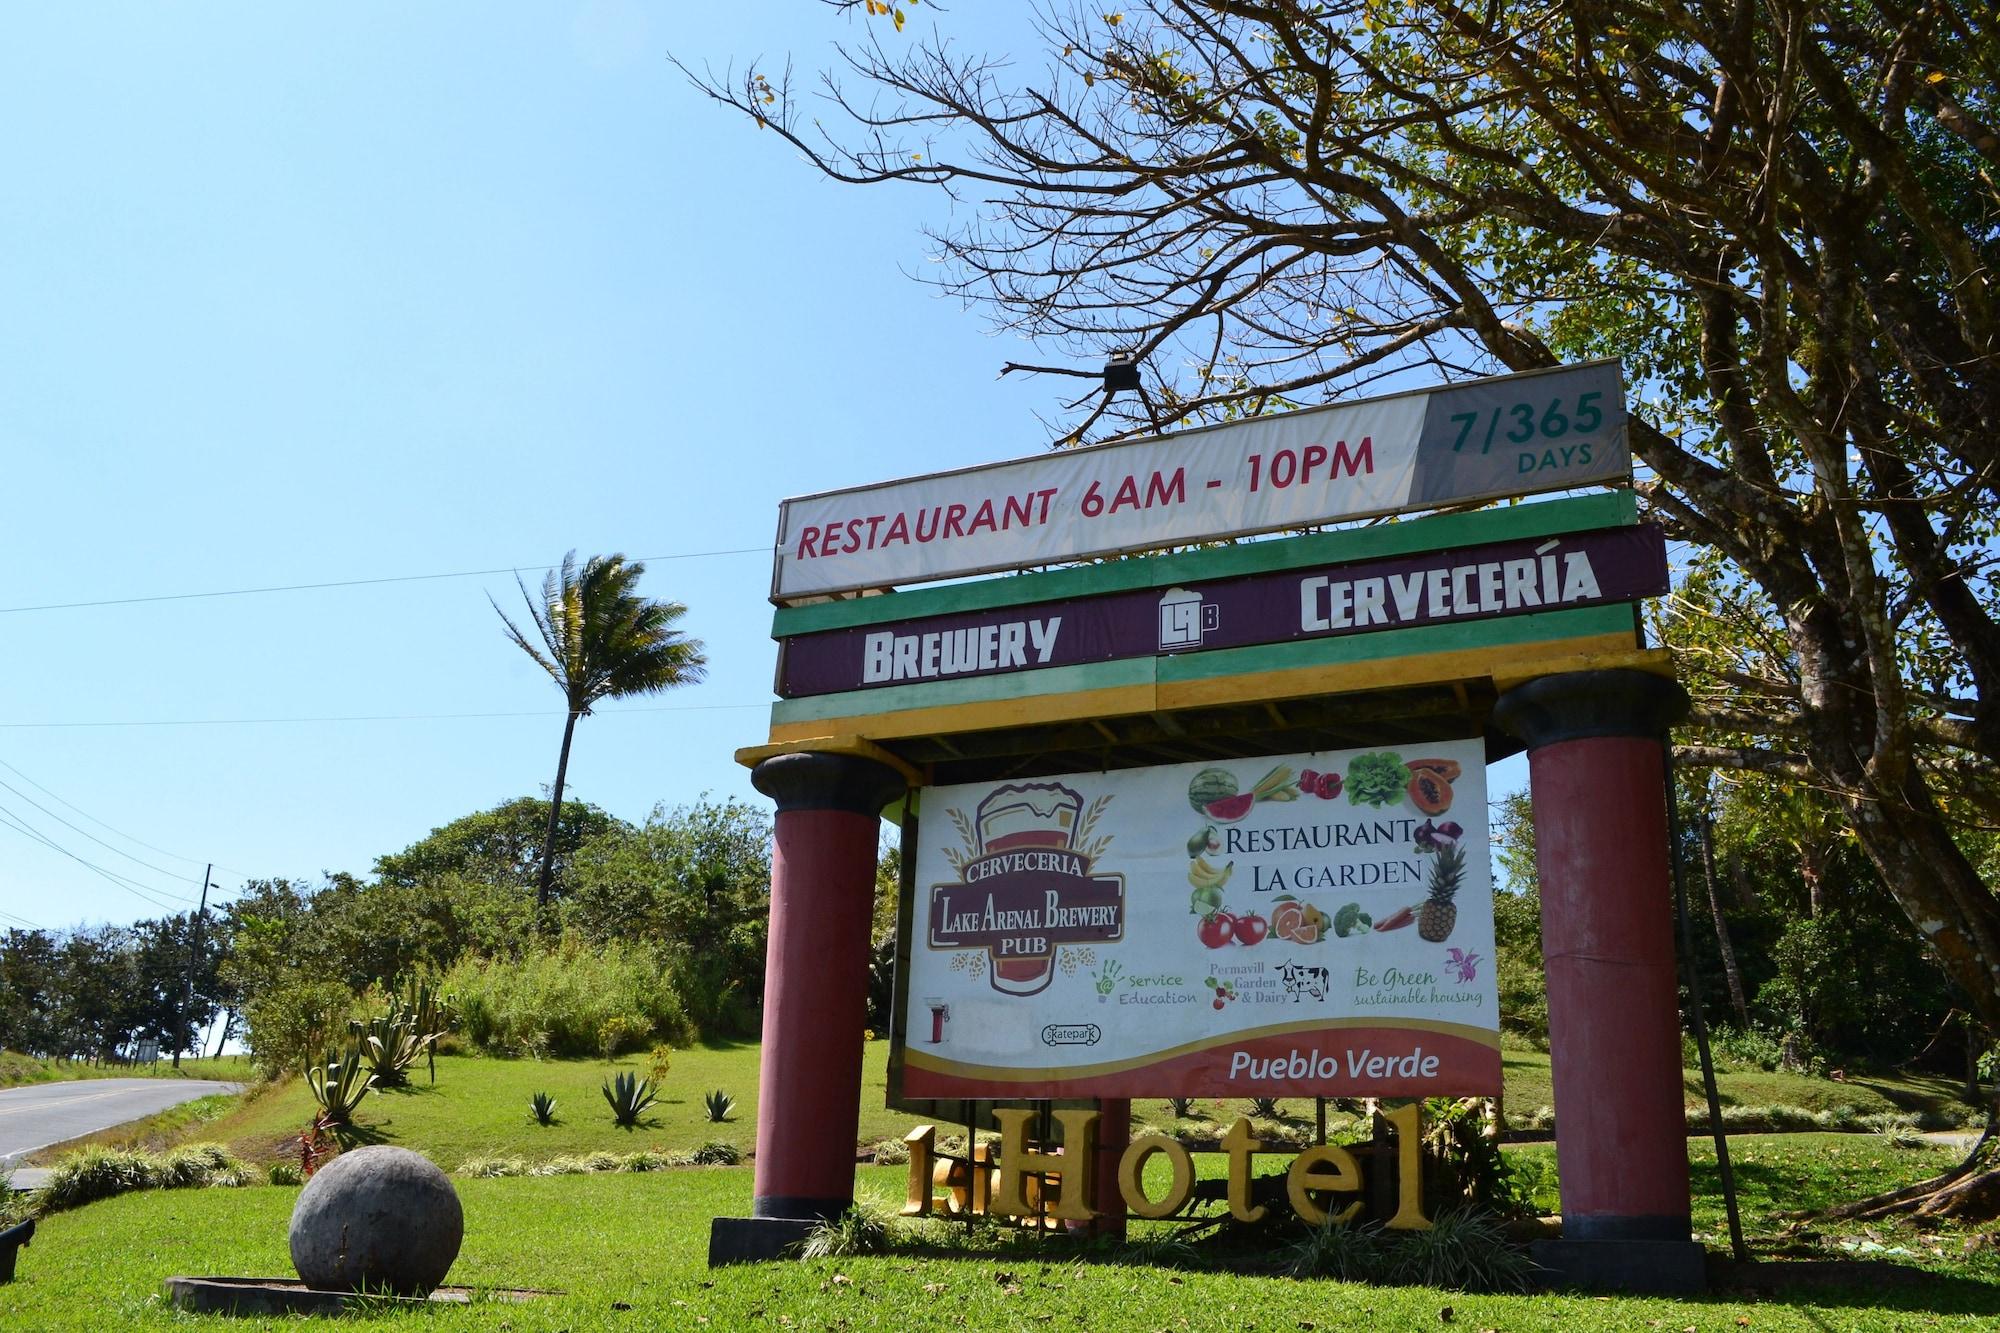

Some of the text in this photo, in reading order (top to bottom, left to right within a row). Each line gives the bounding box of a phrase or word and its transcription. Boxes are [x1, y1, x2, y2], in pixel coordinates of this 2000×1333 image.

[1450, 391, 1603, 454] 7/365
[1517, 443, 1593, 474] DAYS
[797, 436, 1375, 560] RESTAURANT 6AM - 10PM
[1300, 538, 1602, 632] CERVECERÍA
[863, 616, 1062, 684] BREWERY
[1225, 819, 1416, 854] RESTAURANT
[966, 852, 1084, 884] CERVECERIA
[1253, 860, 1423, 892] LA GARDEN
[941, 889, 1118, 934] LAKE ARENAL BREWERY
[1000, 937, 1047, 955] PUB
[1129, 974, 1184, 987] Service
[1209, 962, 1265, 976] Permavill
[1234, 976, 1277, 989] Garden
[1356, 966, 1437, 988] Be Green
[1119, 993, 1197, 1005] Education
[1241, 990, 1287, 1005] & Dairy
[1354, 987, 1483, 1008] sustainable housing
[1047, 1029, 1096, 1041] skatepark
[1229, 1048, 1440, 1080] Pueblo Verde
[990, 1103, 1434, 1230] Hotel
